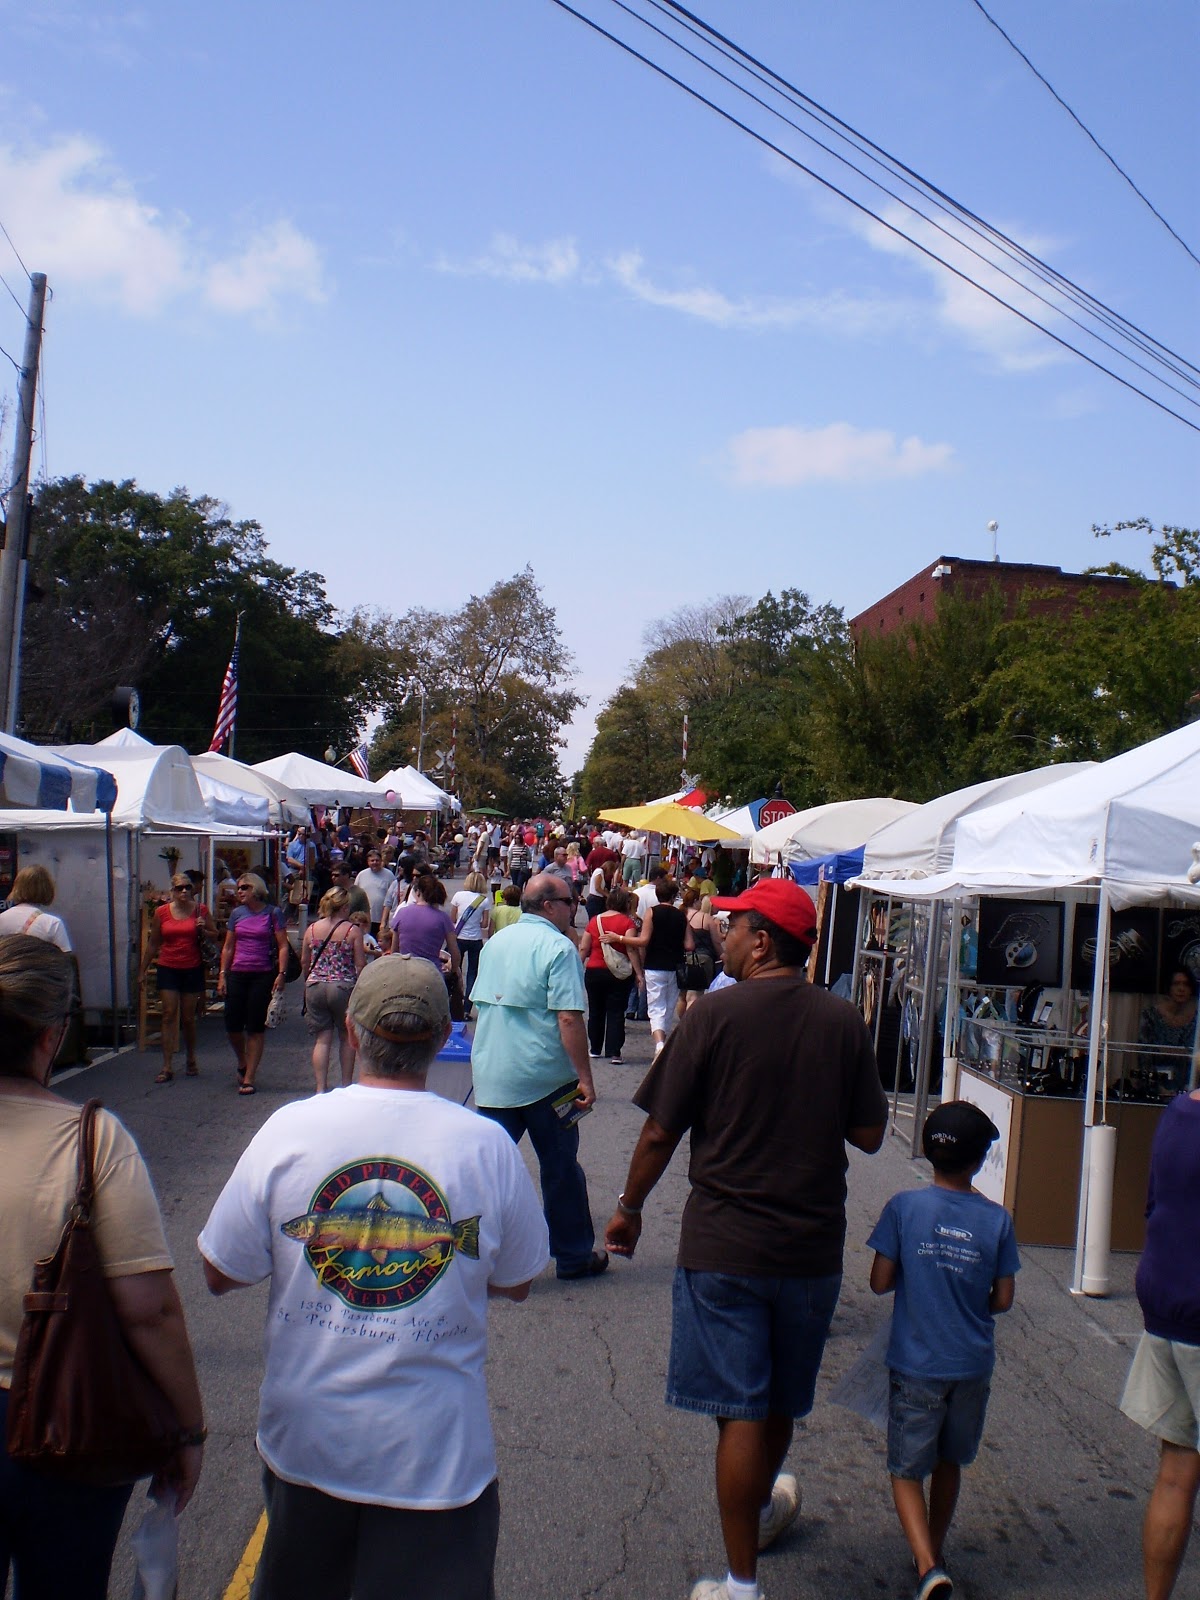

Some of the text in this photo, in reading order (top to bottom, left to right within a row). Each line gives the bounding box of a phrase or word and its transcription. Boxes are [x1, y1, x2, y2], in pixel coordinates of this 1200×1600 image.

[361, 1163, 445, 1219] PETERS
[310, 1245, 454, 1289] Famous
[396, 1263, 438, 1300] FISH
[300, 1300, 332, 1313] 1350
[341, 1308, 397, 1325] Pasadena
[404, 1316, 430, 1328] Ave
[412, 1325, 469, 1343] Florida
